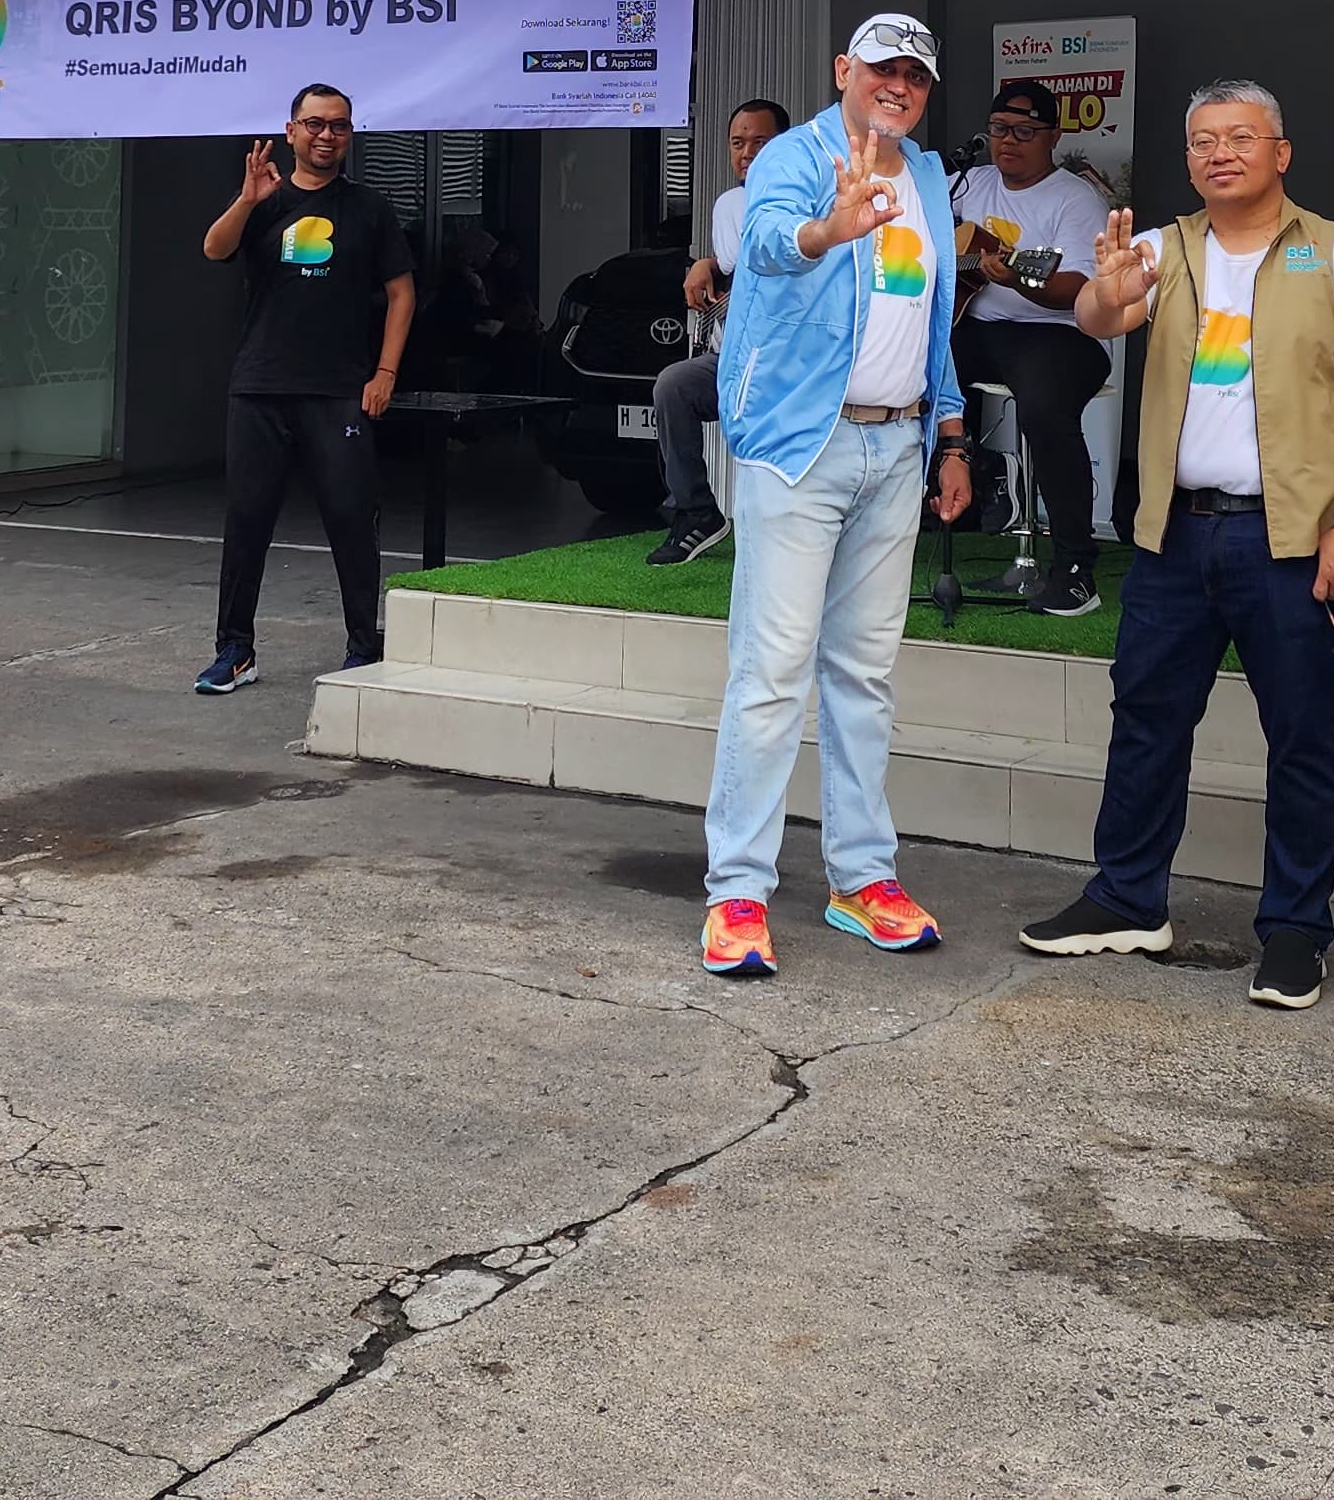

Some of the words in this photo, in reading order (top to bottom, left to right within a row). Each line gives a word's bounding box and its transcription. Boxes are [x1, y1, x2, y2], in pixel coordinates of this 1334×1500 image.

[66, 0, 158, 38] QRIS
[521, 18, 564, 29] Download
[566, 17, 611, 29] Sekarang!
[1001, 35, 1052, 56] Safira
[1062, 37, 1087, 54] BSI
[65, 54, 247, 77] #SemuaJadiMudah
[541, 59, 567, 70] Google
[568, 59, 585, 69] Play
[611, 59, 629, 69] App
[630, 58, 652, 68] Store
[1097, 76, 1113, 91] DI
[1055, 94, 1104, 131] LO
[1286, 243, 1315, 259] BSI
[301, 267, 312, 277] by
[314, 268, 328, 277] BSI
[621, 407, 630, 427] H
